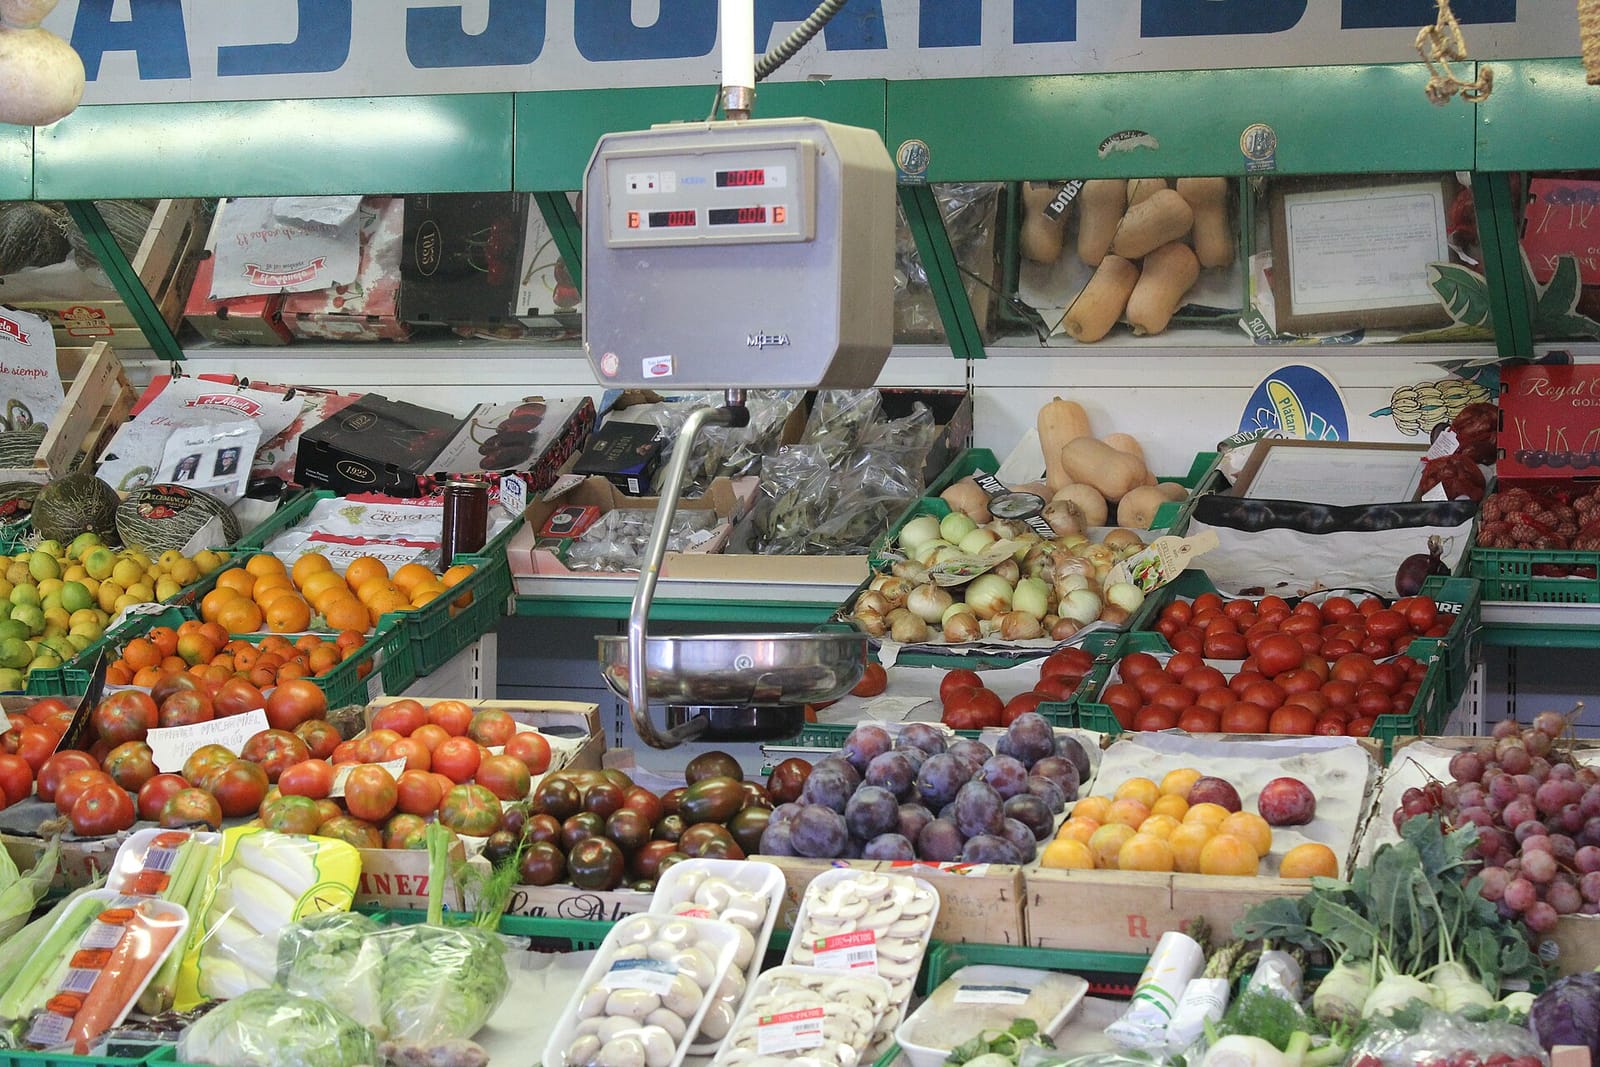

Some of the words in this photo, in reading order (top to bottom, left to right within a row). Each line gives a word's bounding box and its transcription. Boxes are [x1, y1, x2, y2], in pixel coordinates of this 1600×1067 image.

[1519, 376, 1586, 402] Royal
[215, 396, 251, 411] Abuelo
[345, 465, 368, 479] 1922
